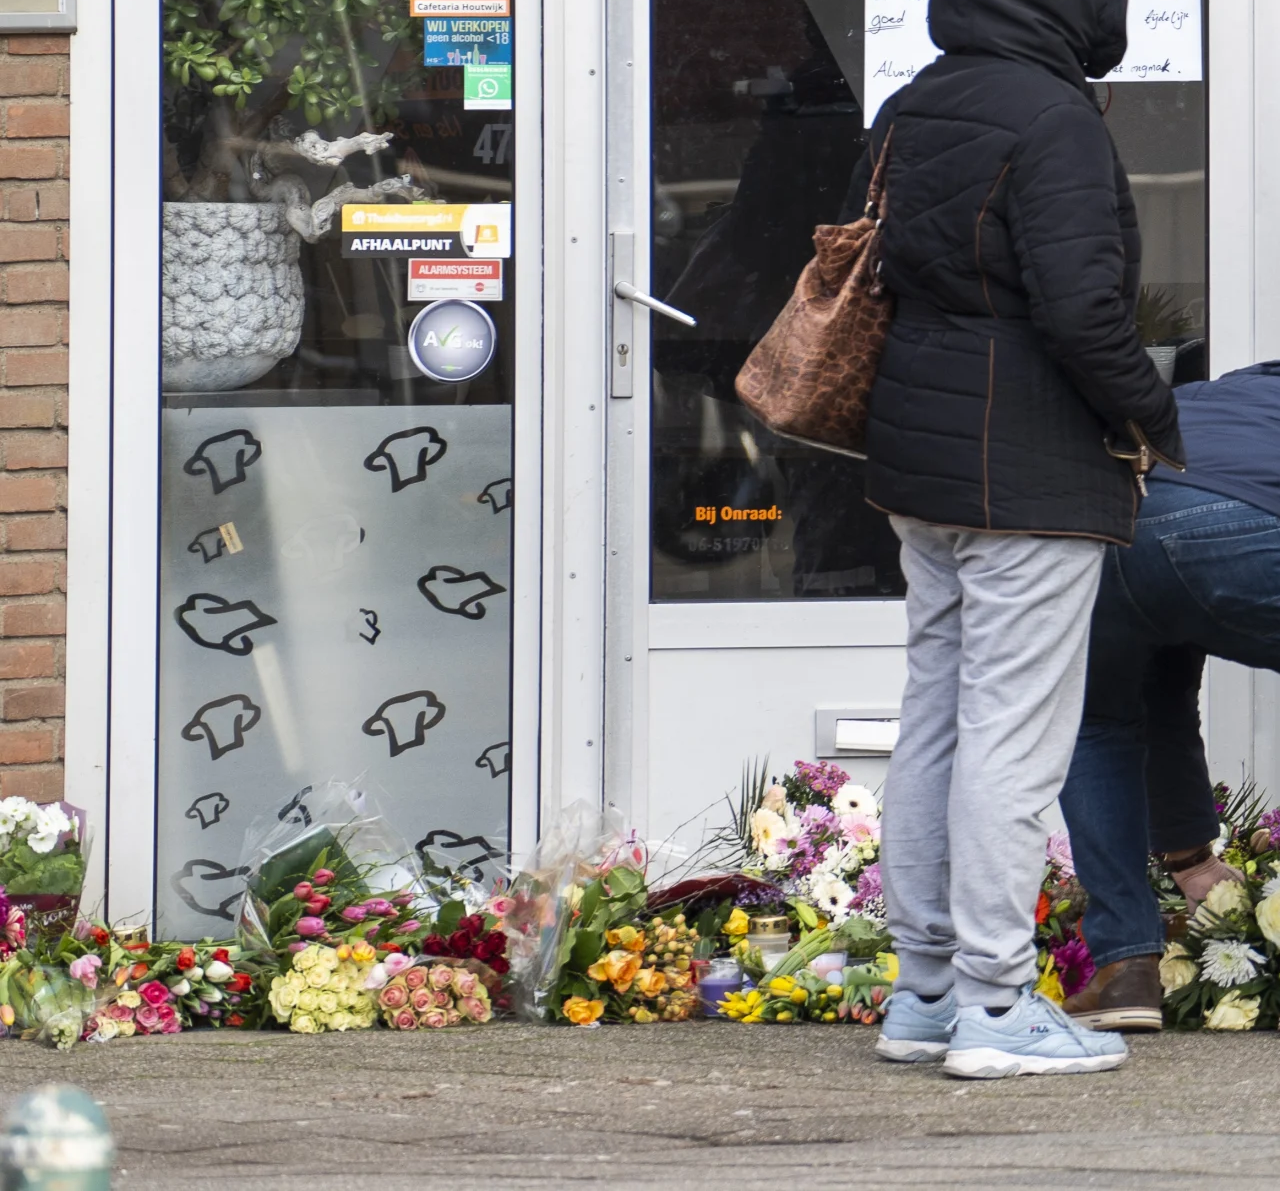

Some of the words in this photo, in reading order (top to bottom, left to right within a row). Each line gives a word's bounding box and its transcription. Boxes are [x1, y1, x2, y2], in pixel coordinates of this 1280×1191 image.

[417, 3, 459, 12] Cafetaria
[462, 3, 504, 13] Houtwijk
[427, 20, 447, 33] WIJ
[450, 20, 510, 33] VERKOPEN
[869, 9, 906, 35] goed
[427, 34, 449, 44] geen
[451, 33, 484, 43] alcohol
[472, 123, 513, 165] 47
[350, 238, 453, 251] AFHAALPUNT
[418, 264, 493, 275] ALARMSYSTEEM
[695, 506, 717, 525] Bij
[720, 505, 782, 521] Onraad:
